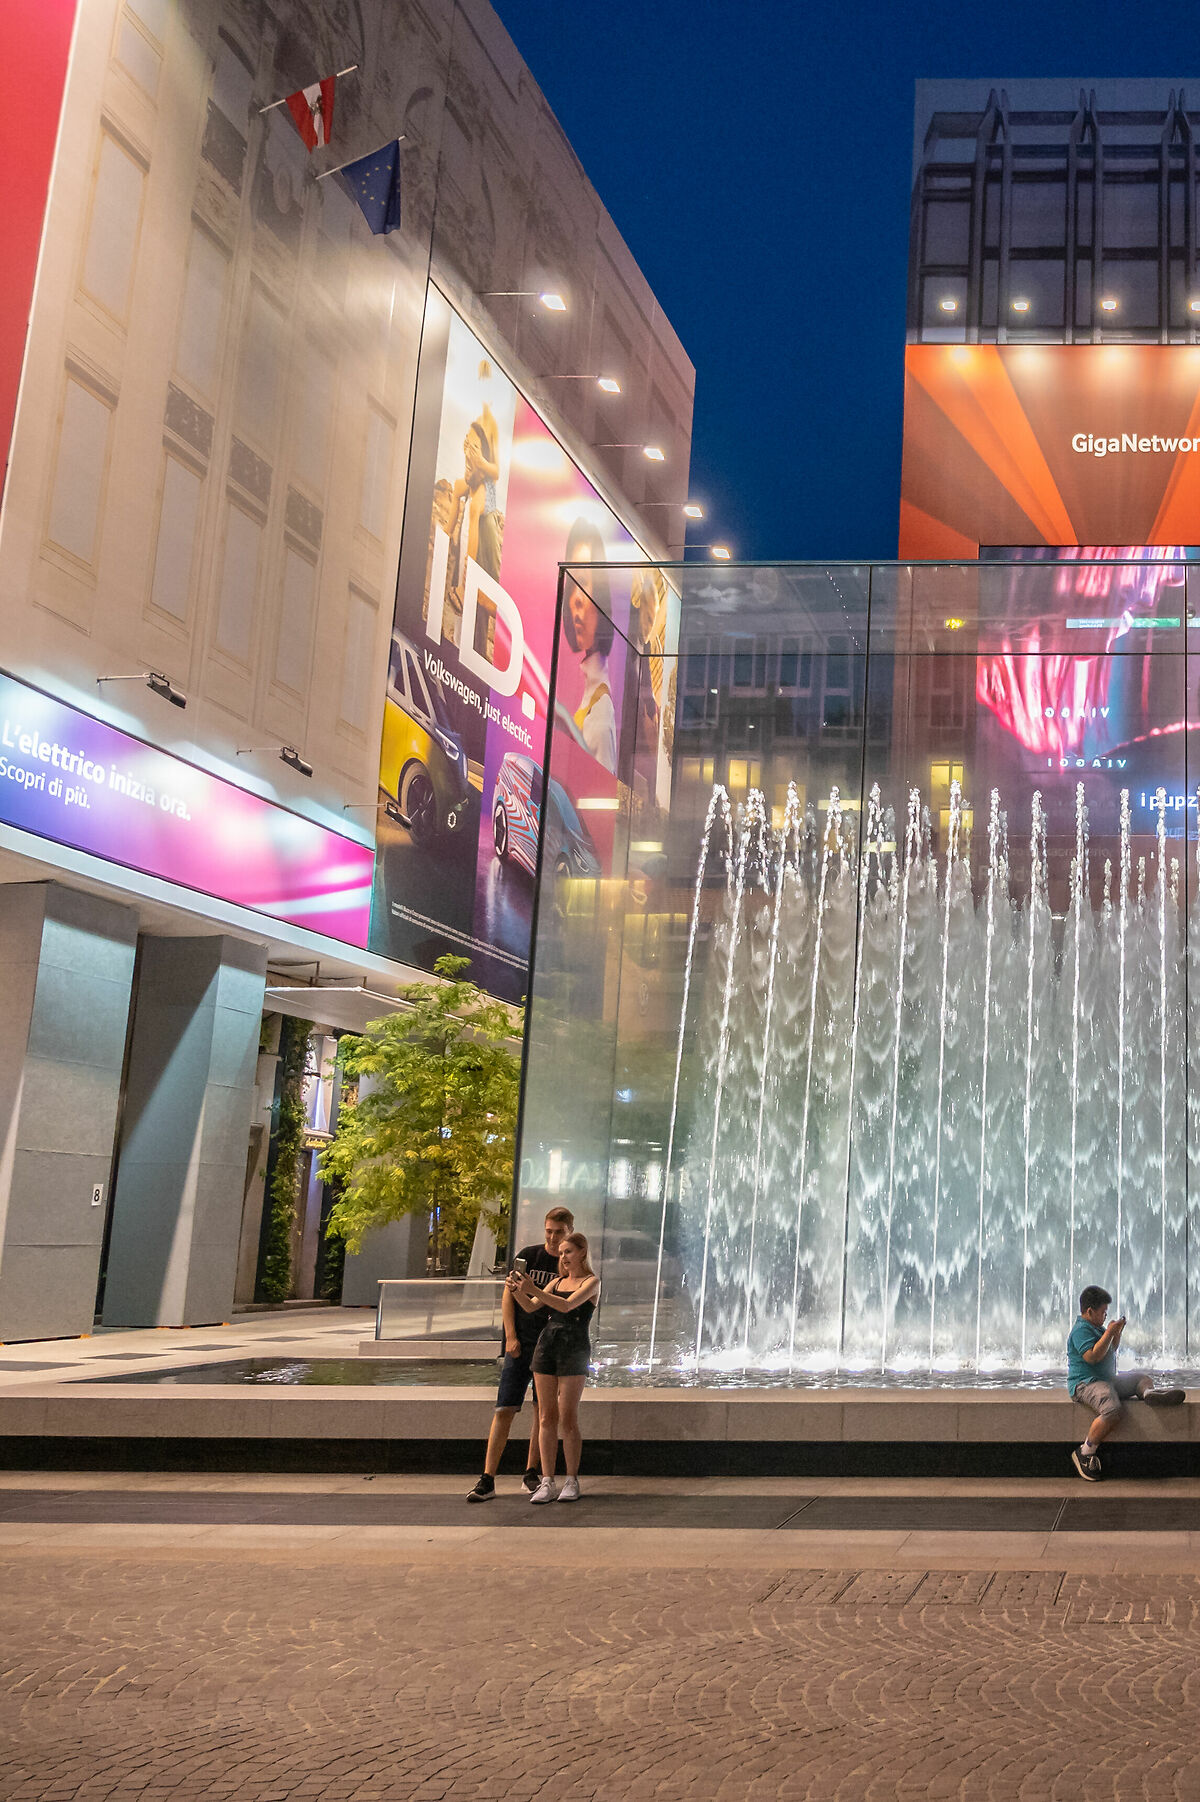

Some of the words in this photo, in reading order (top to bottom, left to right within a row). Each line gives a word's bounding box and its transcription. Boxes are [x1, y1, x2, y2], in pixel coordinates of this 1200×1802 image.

[424, 648, 483, 715] Volkswagen,
[483, 697, 501, 726] just
[502, 715, 533, 750] electric.
[0, 756, 46, 790] Scopri
[48, 777, 63, 798] di
[64, 785, 91, 809] più.
[2, 719, 106, 784] L'elettrico
[109, 764, 156, 806] inizia
[159, 792, 192, 822] ora.
[94, 1188, 101, 1202] 8
